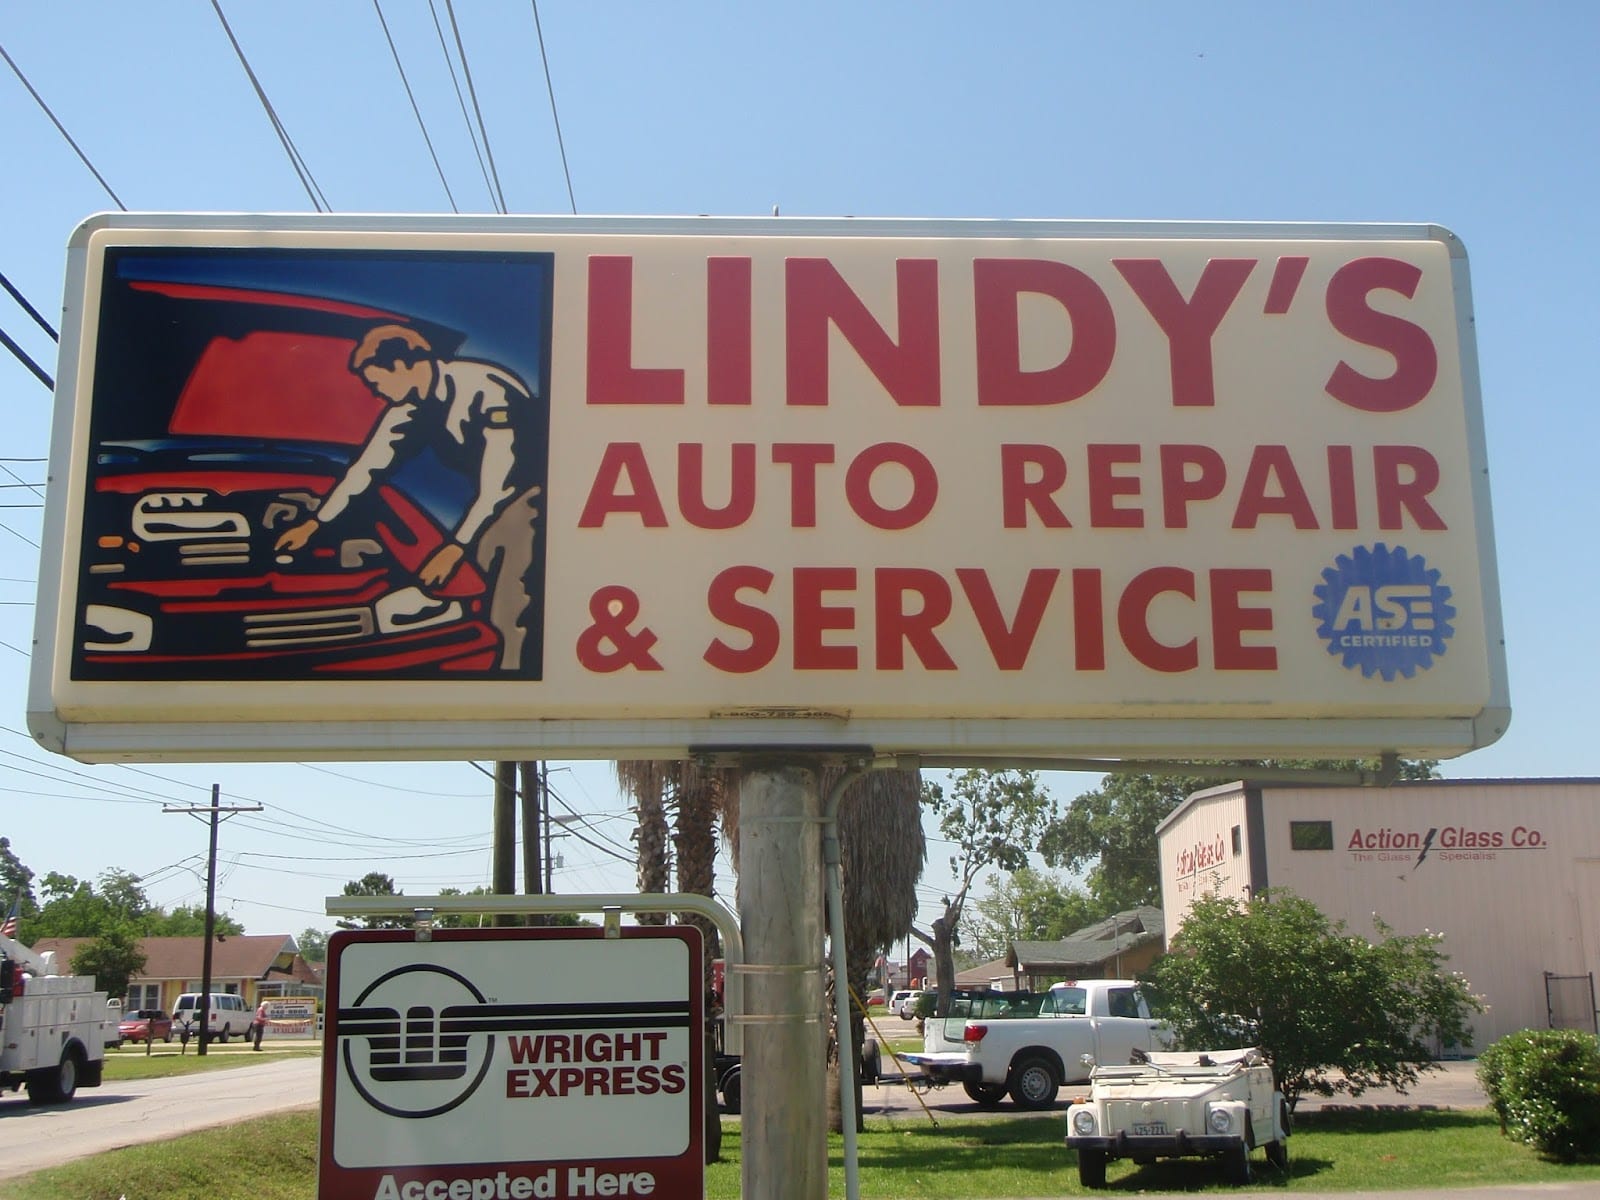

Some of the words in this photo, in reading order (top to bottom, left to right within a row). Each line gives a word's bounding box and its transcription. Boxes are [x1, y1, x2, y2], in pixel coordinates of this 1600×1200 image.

[586, 255, 1438, 412] LINDY'S
[577, 441, 939, 530] AUTO
[1001, 443, 1448, 531] REPAIR
[576, 585, 664, 673] &
[703, 565, 1278, 673] SERVICE
[1332, 585, 1435, 631] ASE
[1340, 635, 1433, 648] CERTIFIED
[1348, 828, 1420, 849] Action
[1440, 826, 1503, 848] Glass
[1511, 826, 1547, 847] Co.
[1378, 851, 1411, 862] Glass
[1439, 850, 1497, 862] Specialist
[507, 1032, 667, 1064] WRIGHT
[506, 1064, 686, 1098] EXPRESS
[374, 1168, 556, 1200] Accepted
[568, 1166, 656, 1197] Here
